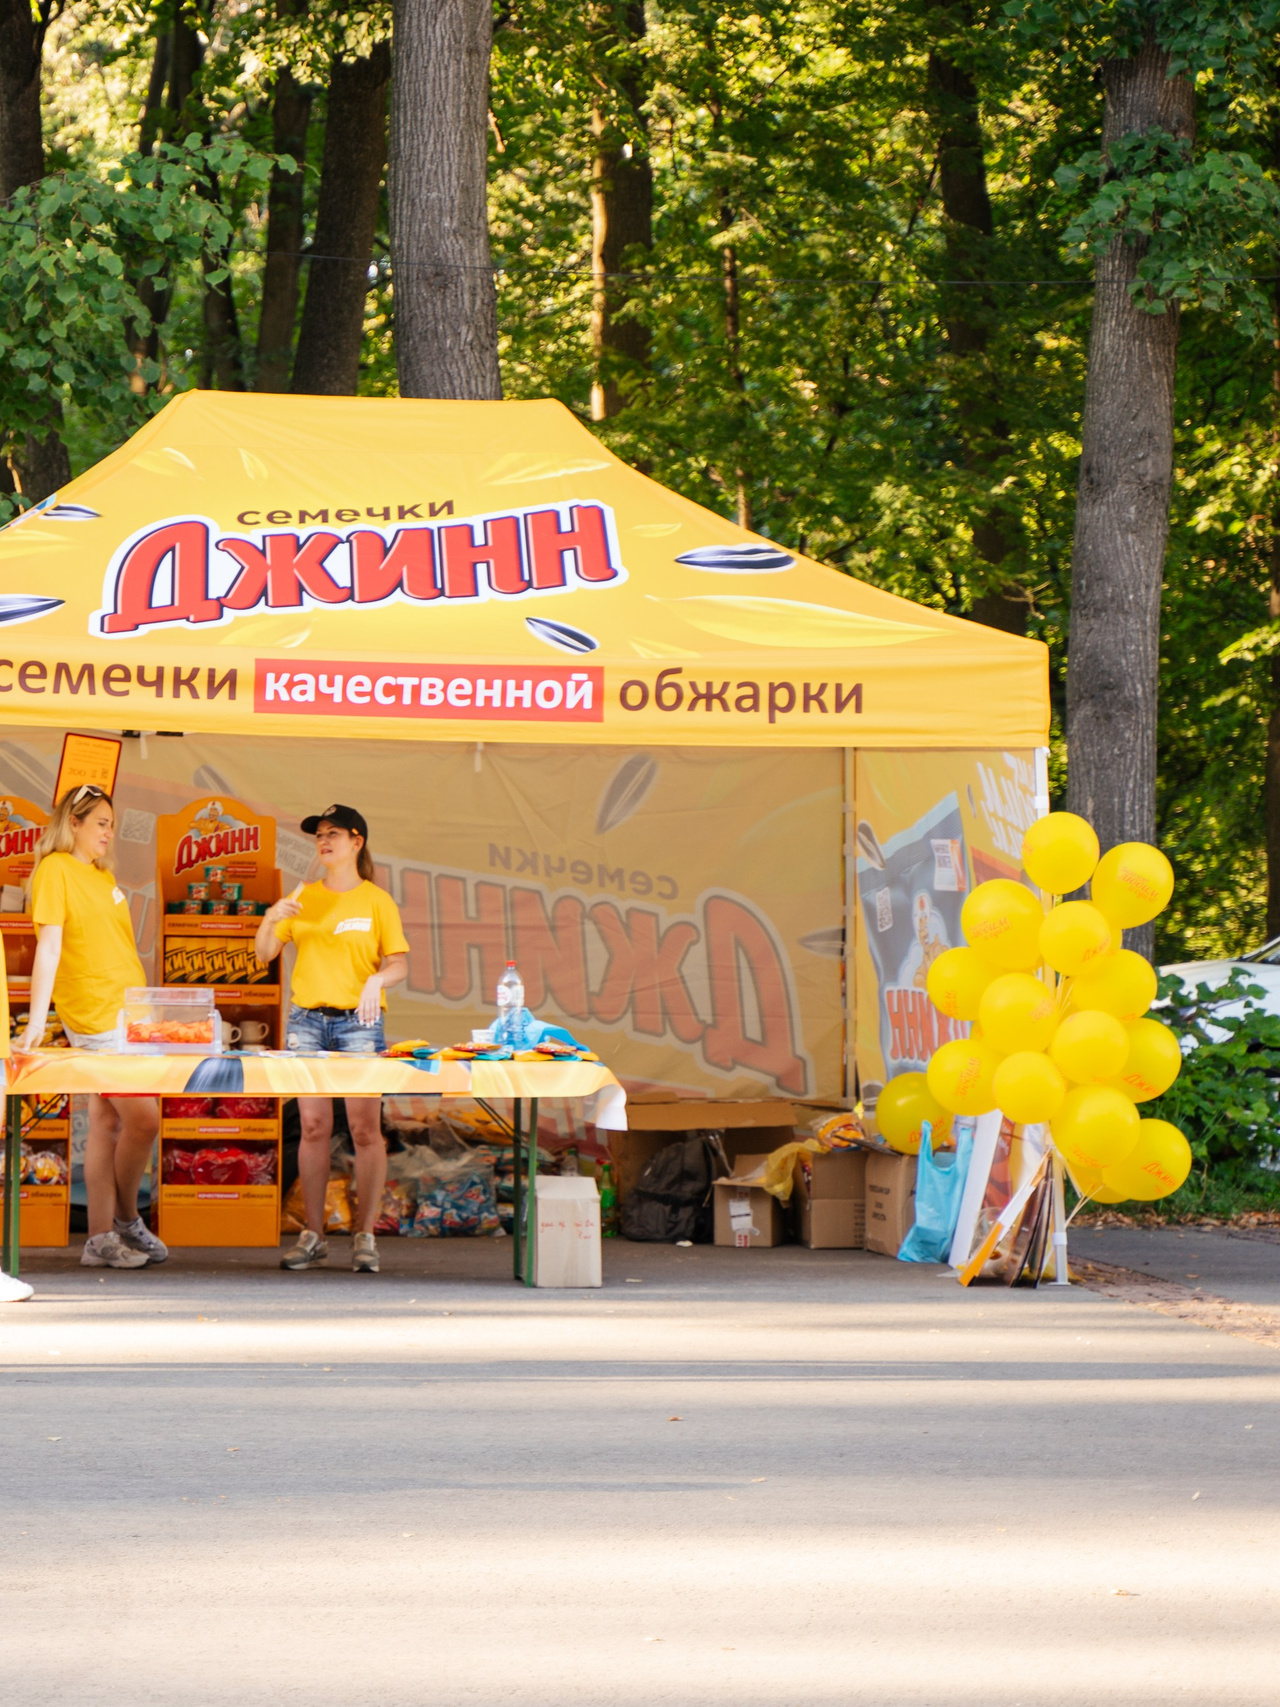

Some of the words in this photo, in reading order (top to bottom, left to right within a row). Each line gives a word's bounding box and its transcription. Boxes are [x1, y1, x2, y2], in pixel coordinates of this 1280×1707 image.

[236, 499, 455, 526] семечки
[98, 503, 619, 635] Джинн
[264, 671, 594, 710] качественной
[619, 666, 864, 724] обжарки
[175, 826, 259, 875] Джинн
